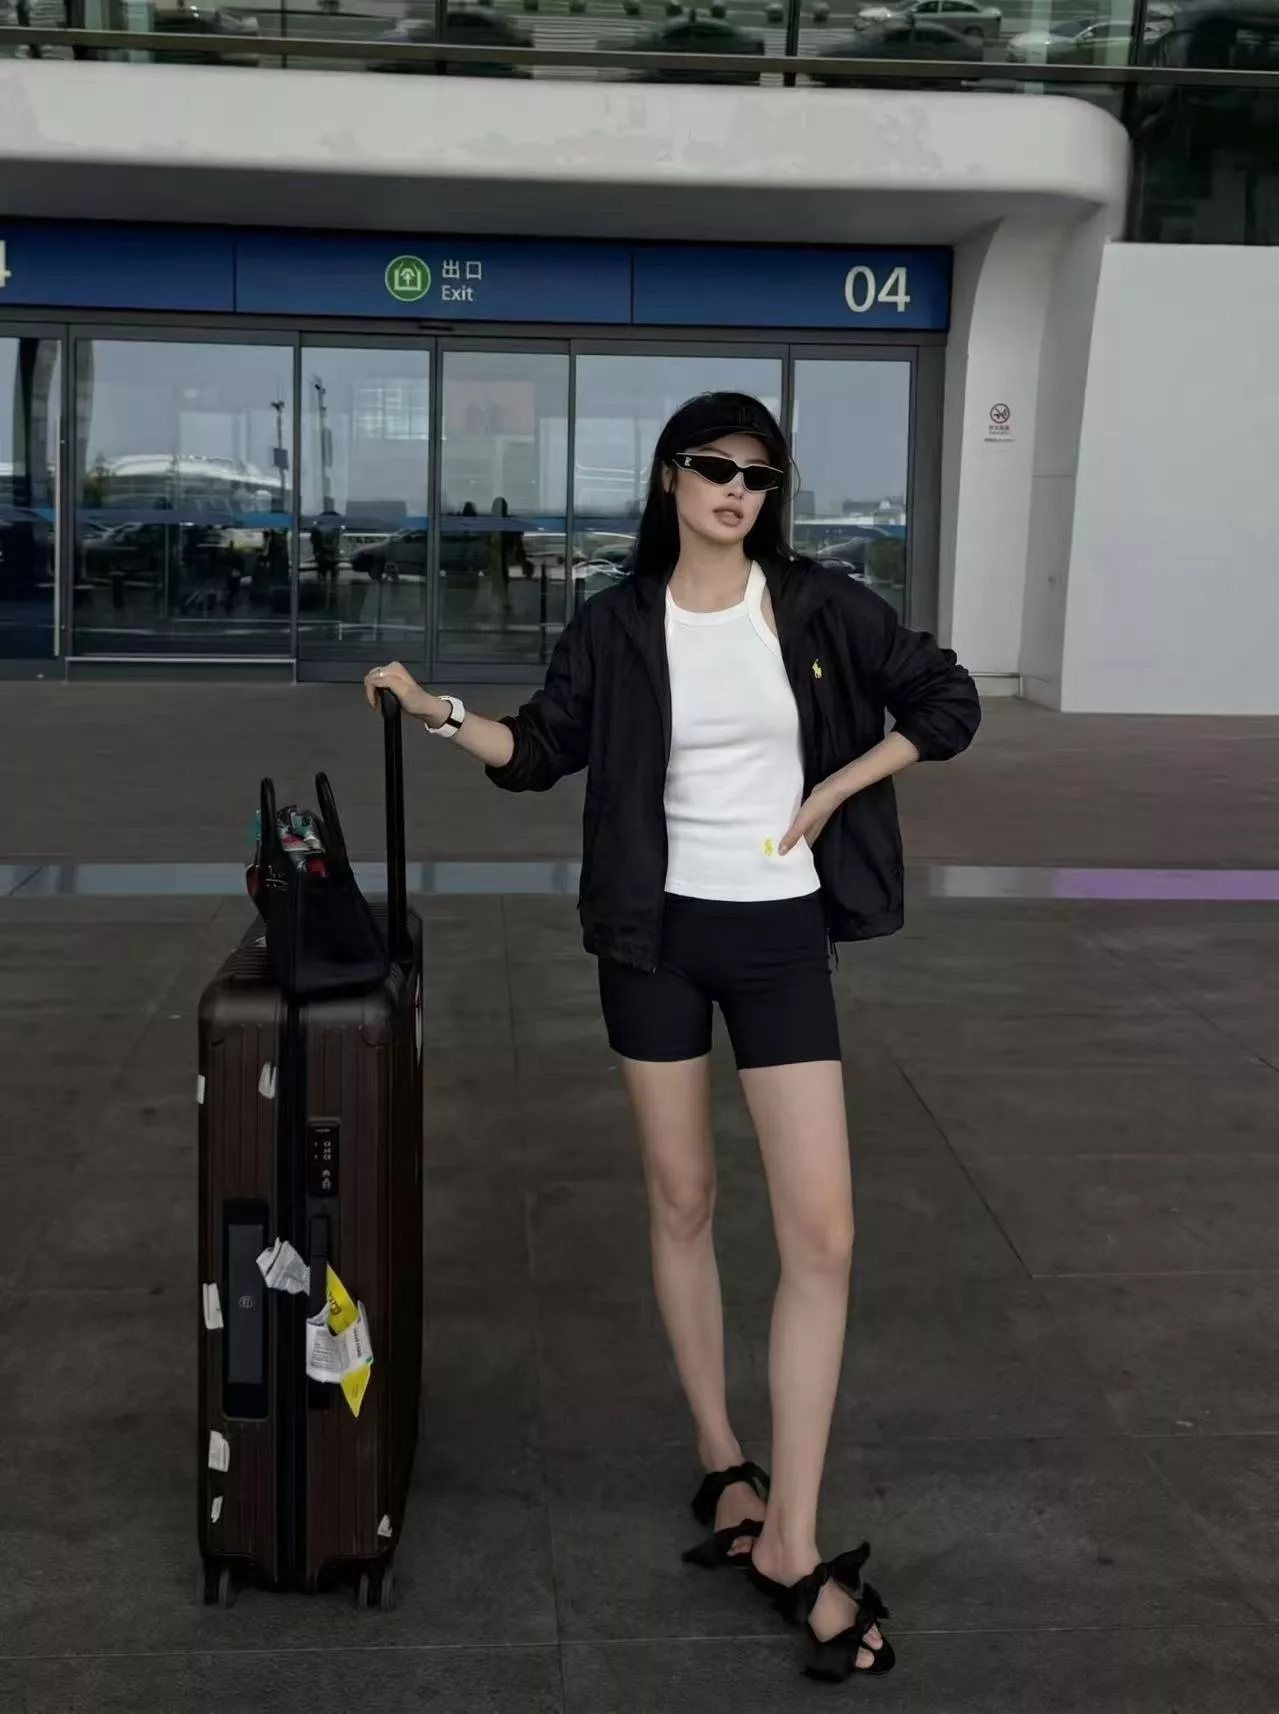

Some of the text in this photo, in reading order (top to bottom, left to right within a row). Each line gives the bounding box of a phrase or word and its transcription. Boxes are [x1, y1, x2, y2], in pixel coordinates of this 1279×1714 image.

[442, 259, 482, 280] 出口
[441, 284, 474, 302] Exit
[845, 265, 911, 312] 04
